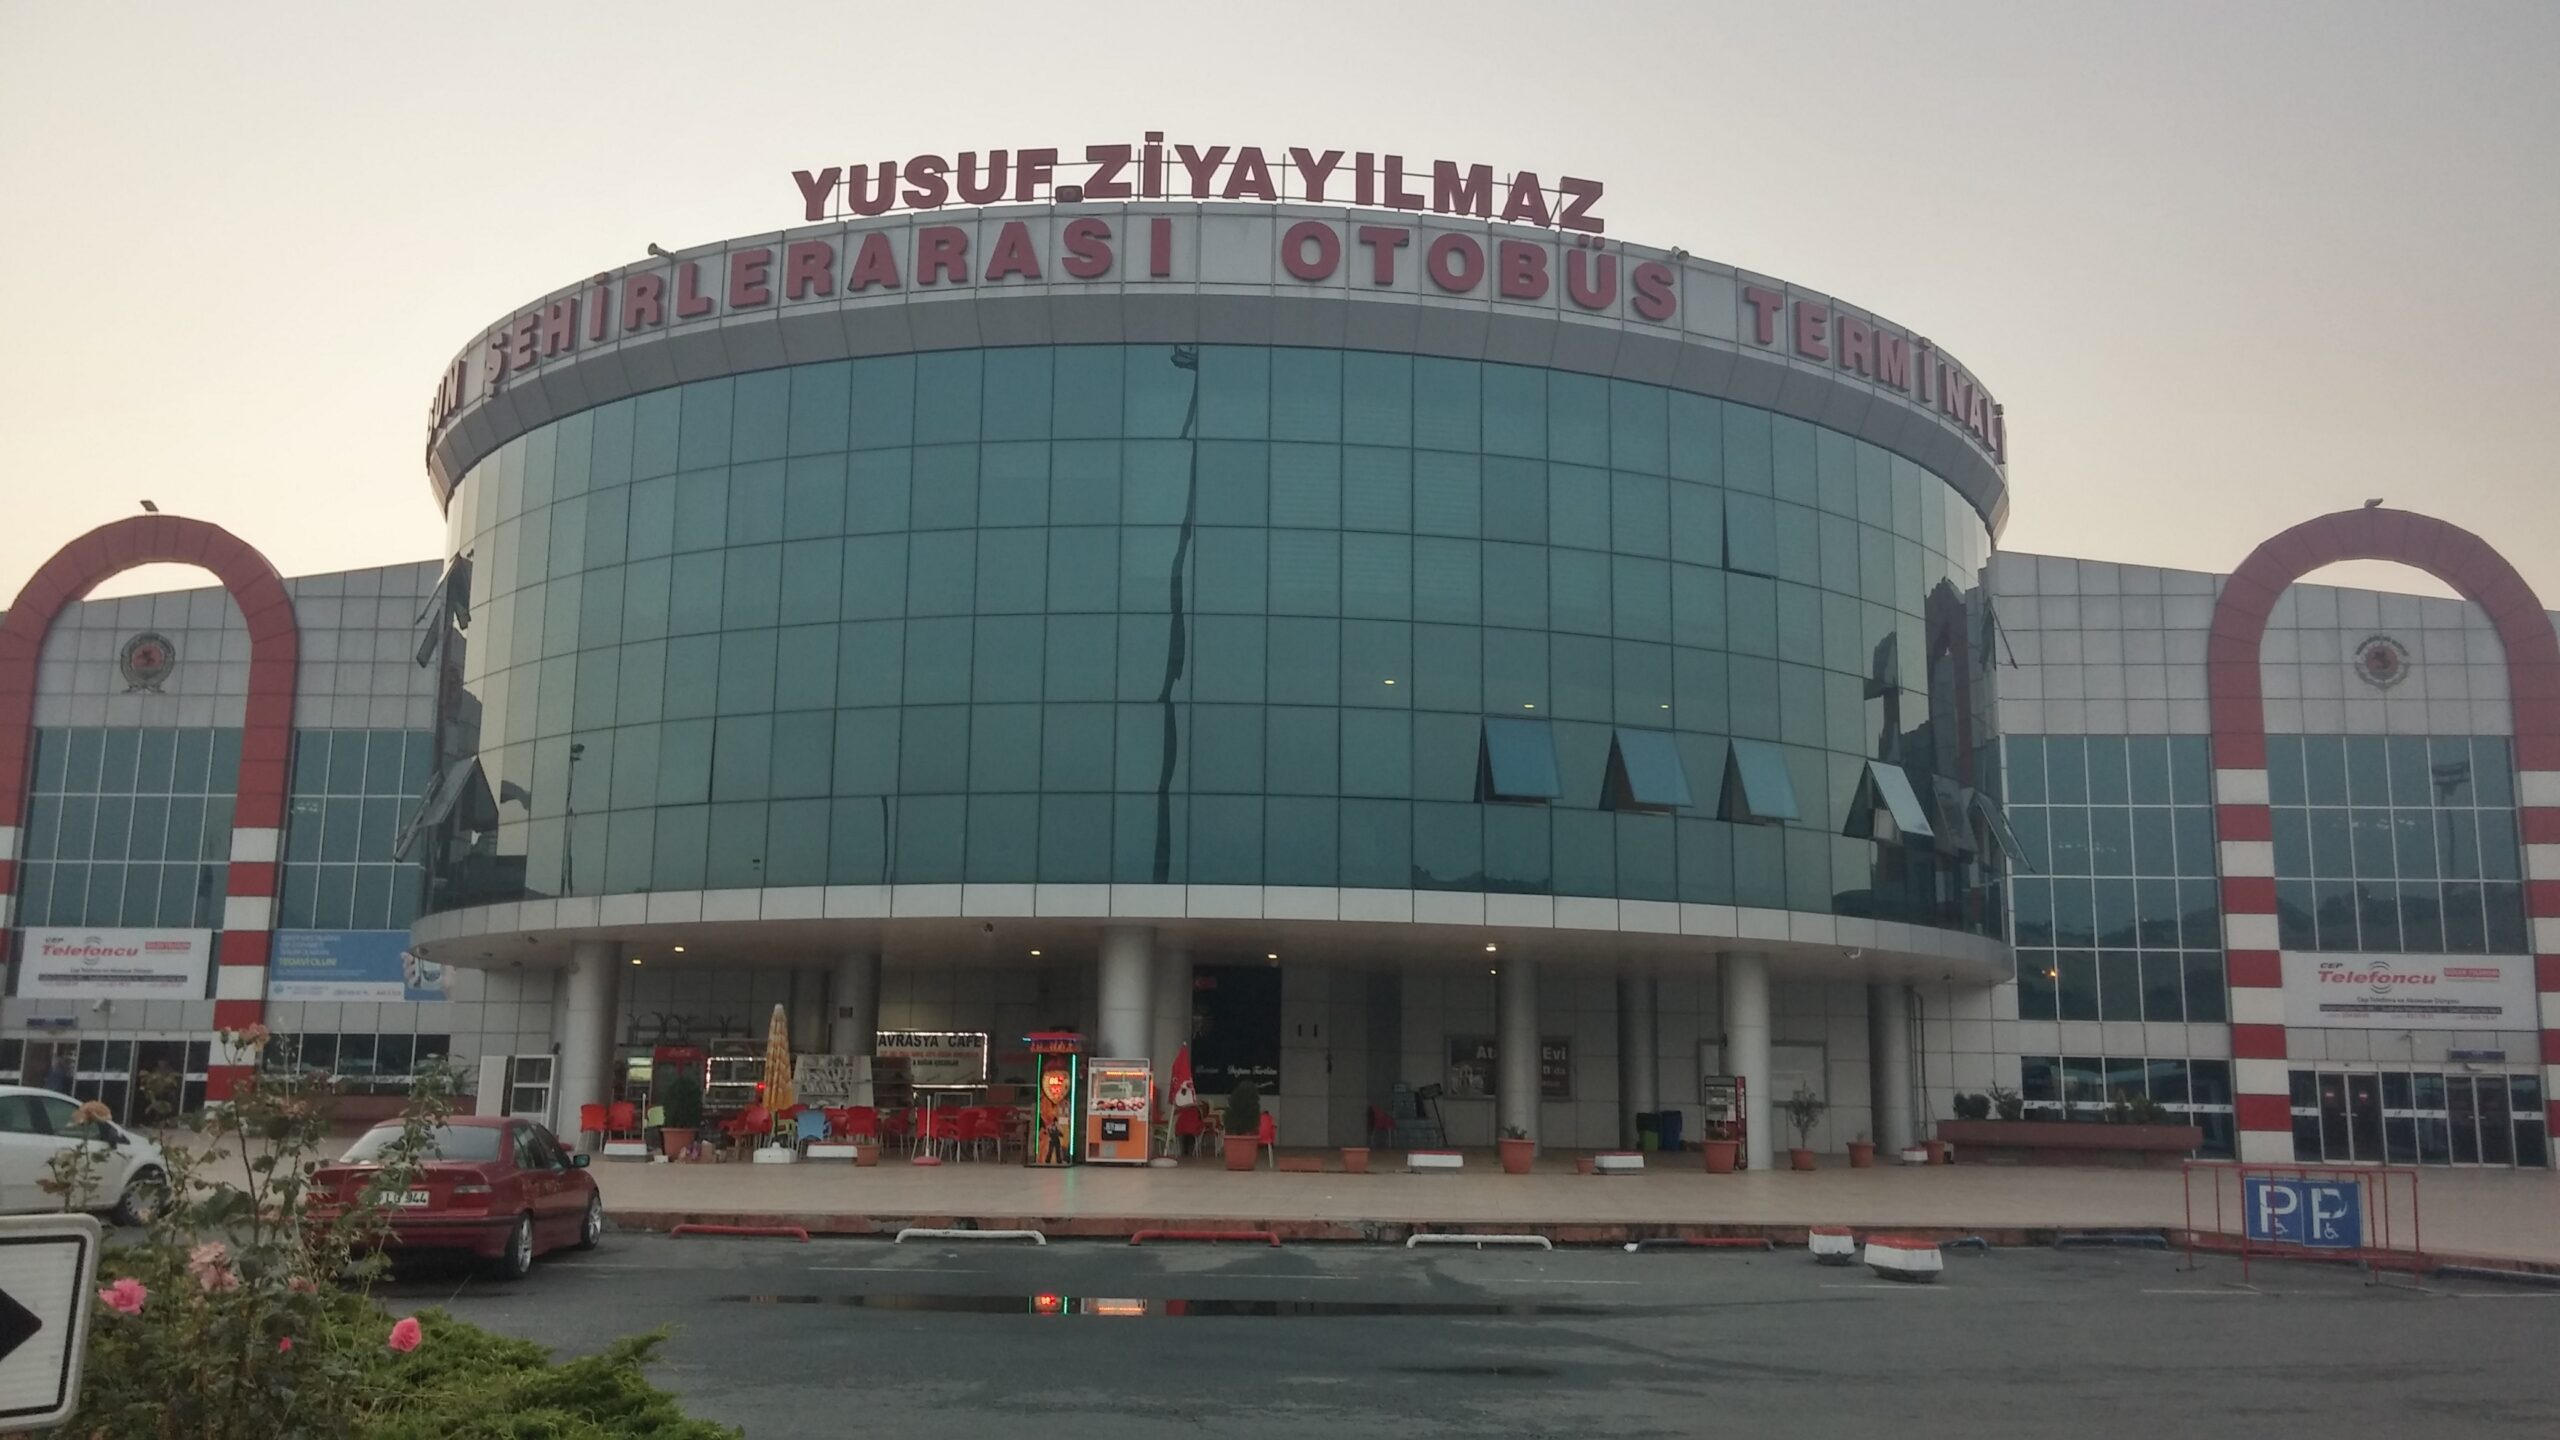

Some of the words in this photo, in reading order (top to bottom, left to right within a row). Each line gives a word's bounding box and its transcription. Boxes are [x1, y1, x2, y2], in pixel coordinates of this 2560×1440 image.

[793, 148, 1057, 221] YUSUF
[484, 217, 1171, 397] ŞEHİRLERARASI
[1283, 220, 1677, 321] OTOBÜS
[41, 944, 138, 957] Telefoncu
[2318, 970, 2437, 985] Telefoncu
[878, 1034, 939, 1047] AVRASYA
[948, 1035, 981, 1047] CAFE
[1543, 1046, 1566, 1060] Evi
[2258, 1184, 2298, 1233] P
